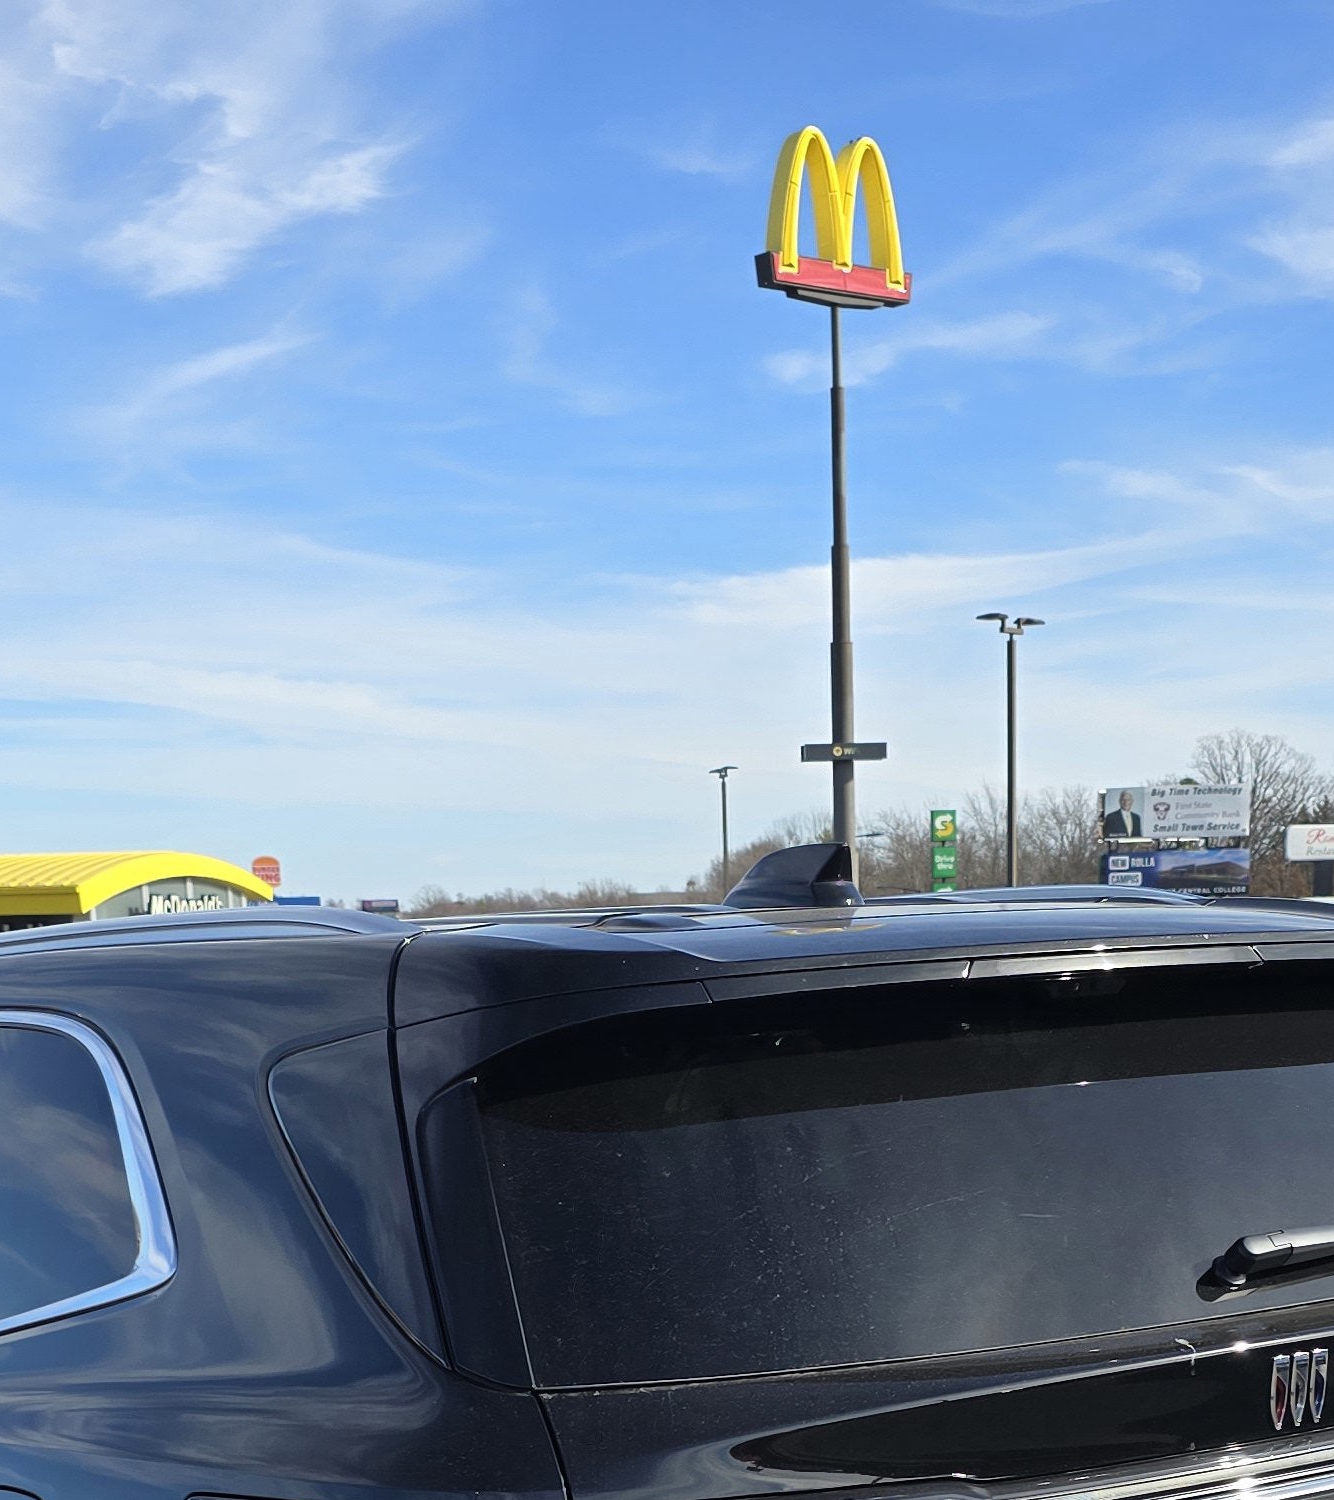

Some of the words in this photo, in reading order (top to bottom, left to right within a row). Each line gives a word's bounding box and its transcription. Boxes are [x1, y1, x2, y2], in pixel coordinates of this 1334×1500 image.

[1151, 788, 1166, 798] Big
[1169, 787, 1190, 796] Time
[1193, 786, 1243, 796] Technology
[1153, 823, 1179, 832] Small
[1181, 823, 1204, 832] Town
[1207, 821, 1241, 831] Service
[1130, 857, 1156, 868] ROLLA
[1213, 885, 1247, 894] COLLEGE
